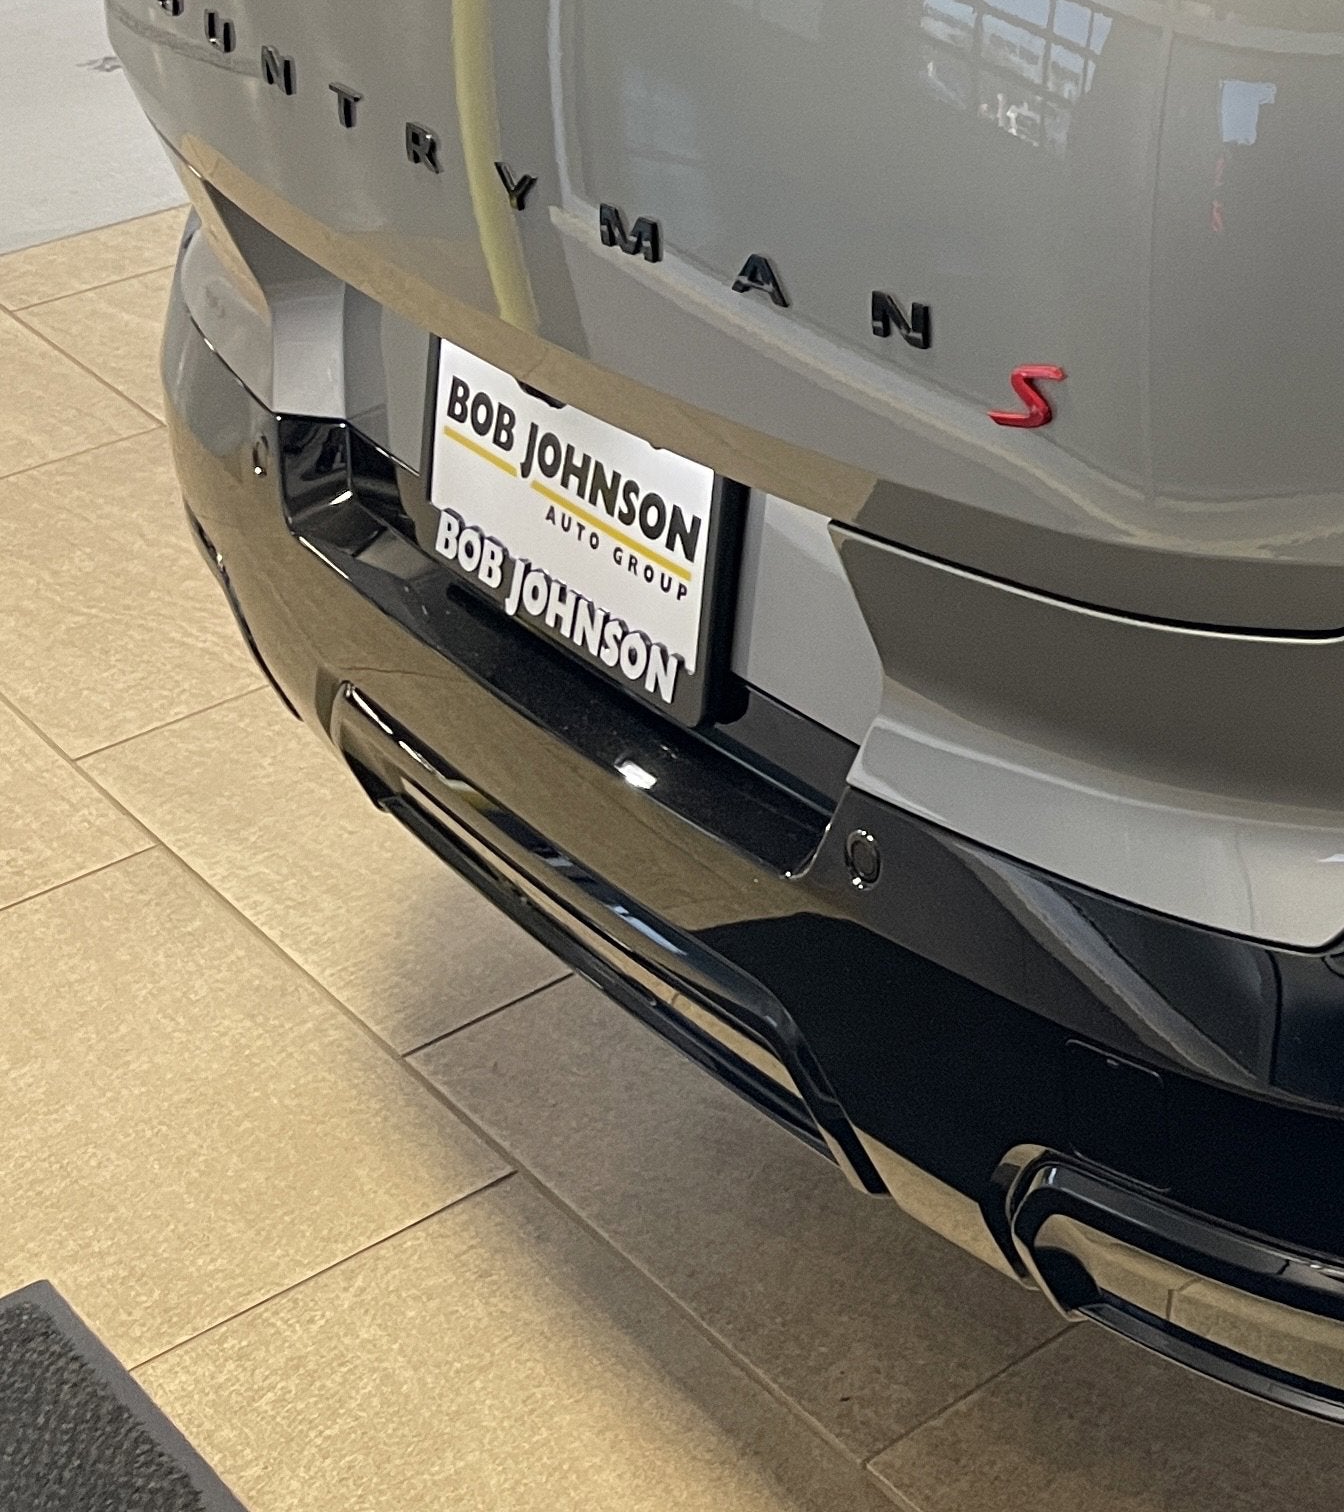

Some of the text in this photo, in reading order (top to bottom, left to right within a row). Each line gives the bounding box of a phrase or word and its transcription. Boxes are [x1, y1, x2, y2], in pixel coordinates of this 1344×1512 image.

[987, 362, 1068, 429] S
[447, 374, 702, 564] BOB JOHNSON
[435, 508, 685, 705] BOB JOHNSON
[544, 505, 690, 601] AUTO GROUP
